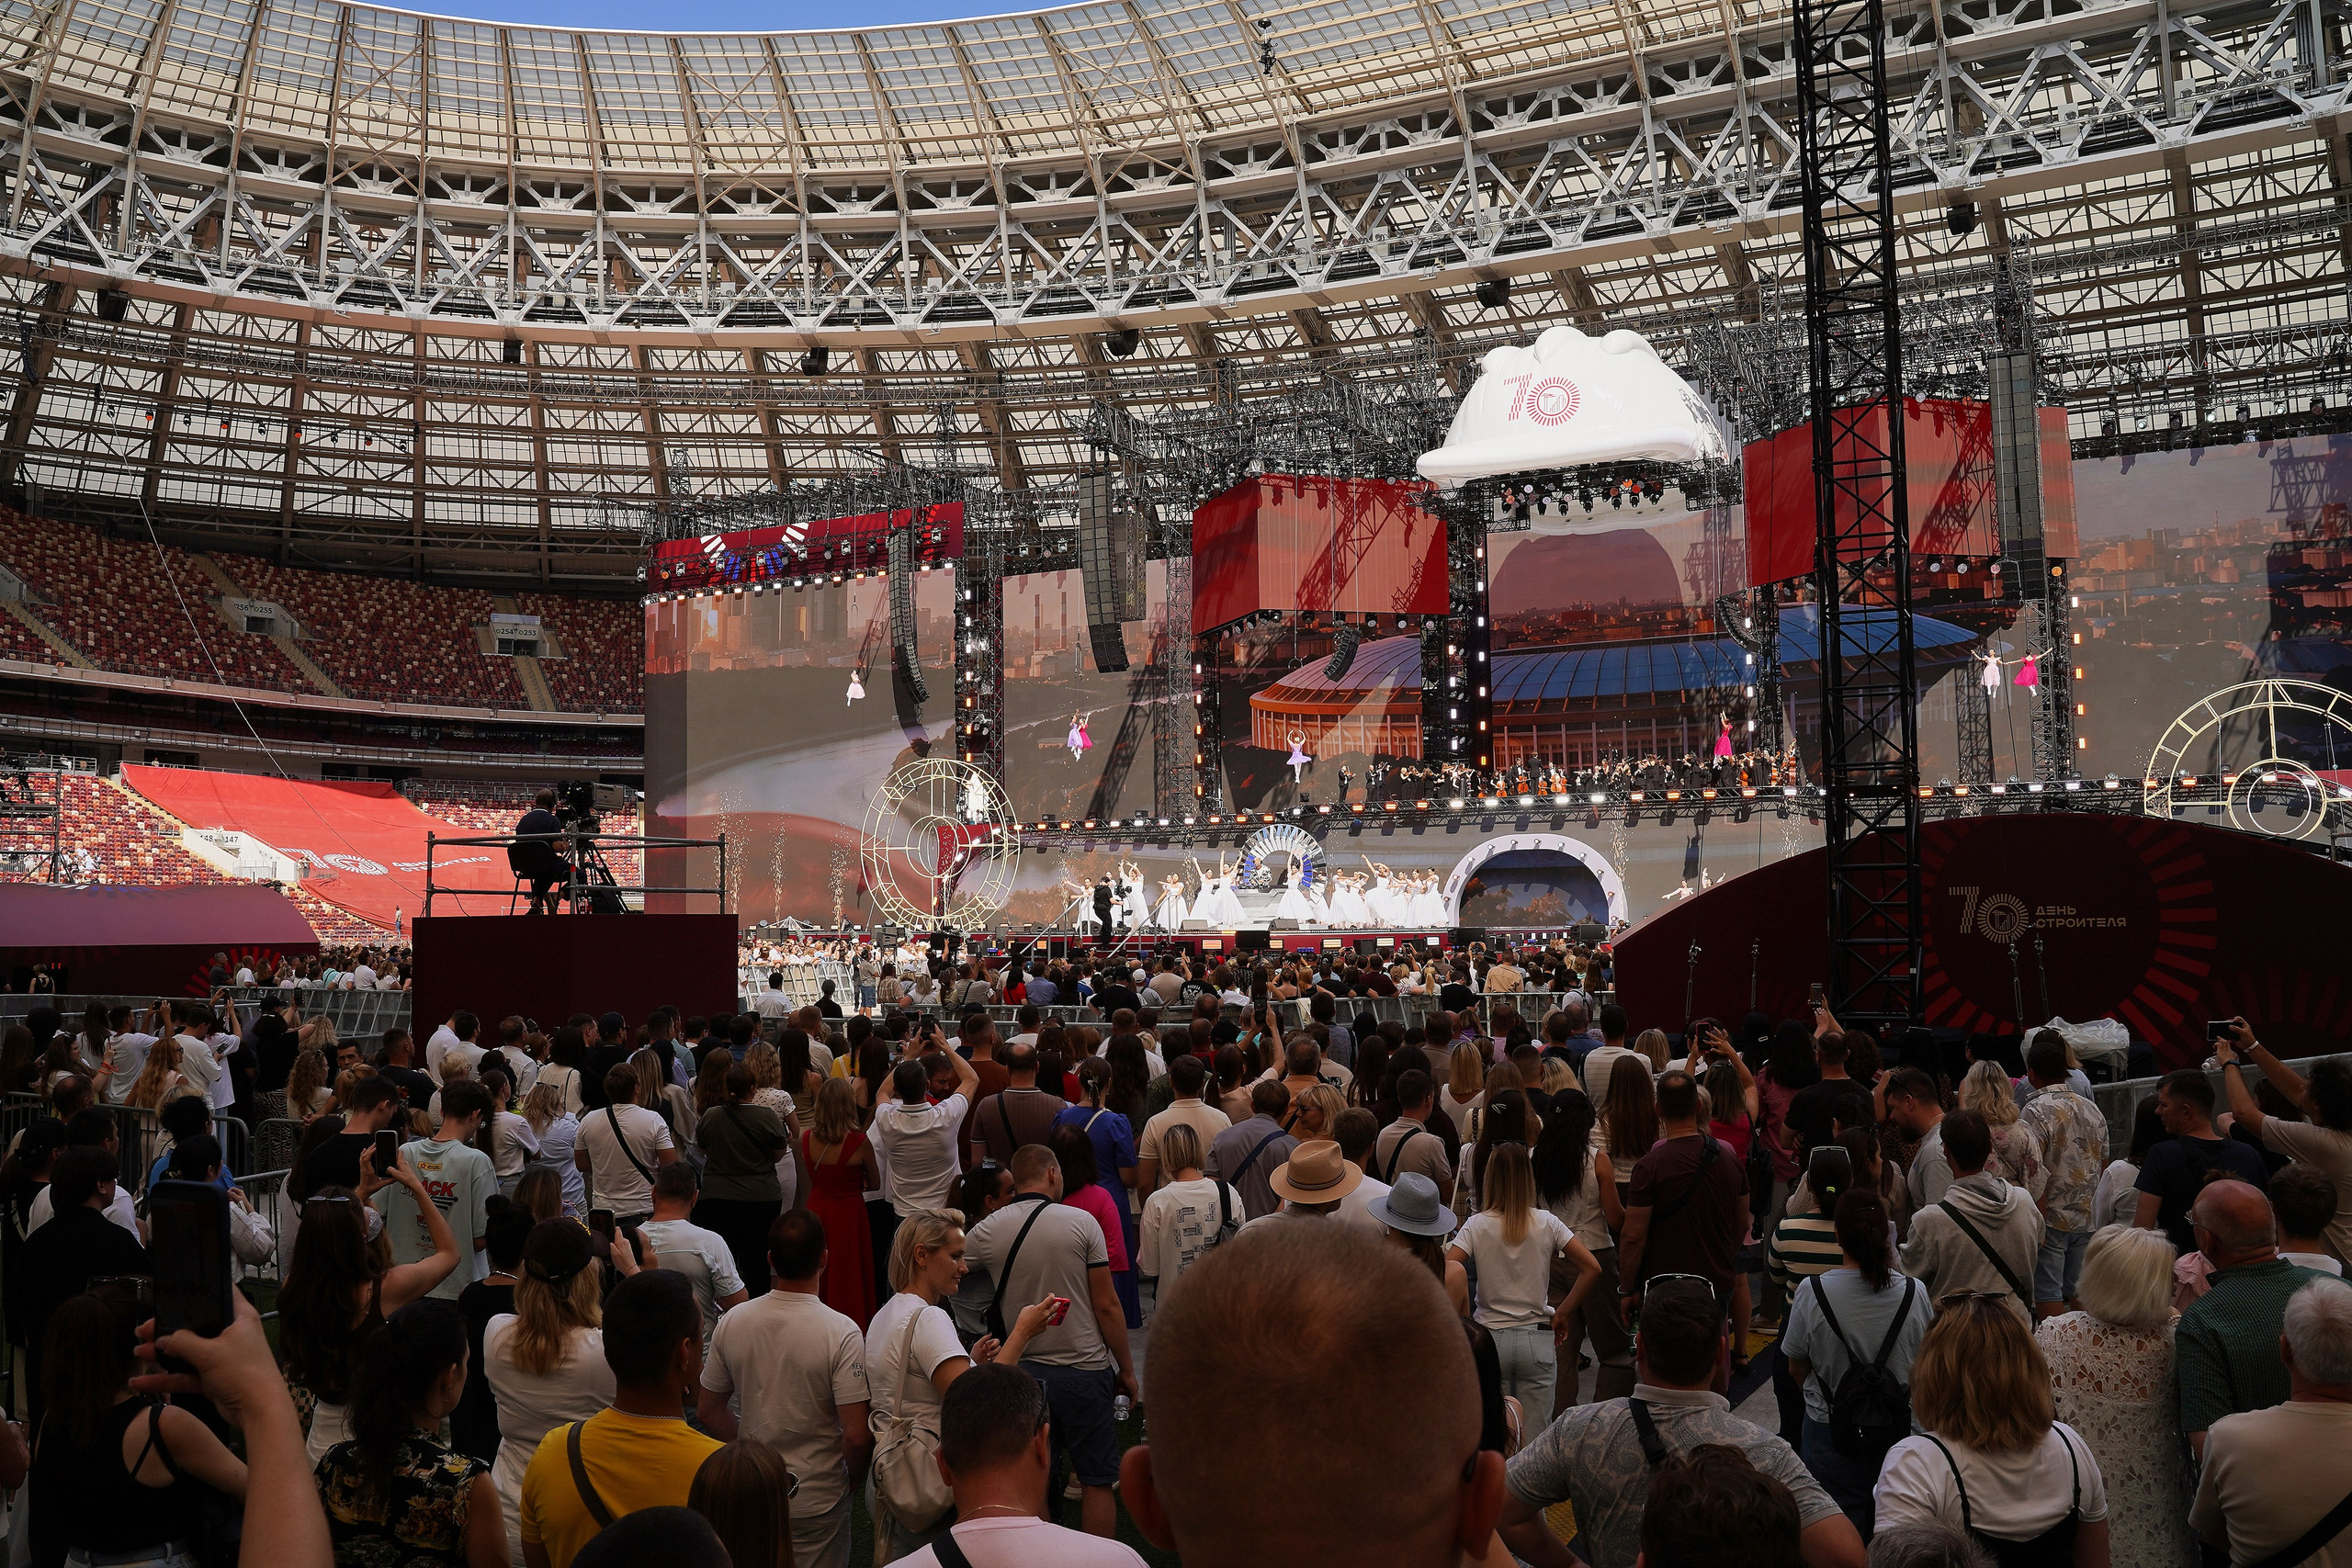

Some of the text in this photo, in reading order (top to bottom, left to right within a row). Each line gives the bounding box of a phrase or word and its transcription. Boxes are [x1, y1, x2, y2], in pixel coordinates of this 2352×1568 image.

[1503, 372, 1581, 427] 70
[259, 606, 273, 615] 255
[1949, 886, 2030, 944] 70
[2035, 906, 2077, 916] ДЕНЬ
[2035, 917, 2127, 929] СТРОИТЕЛЯ
